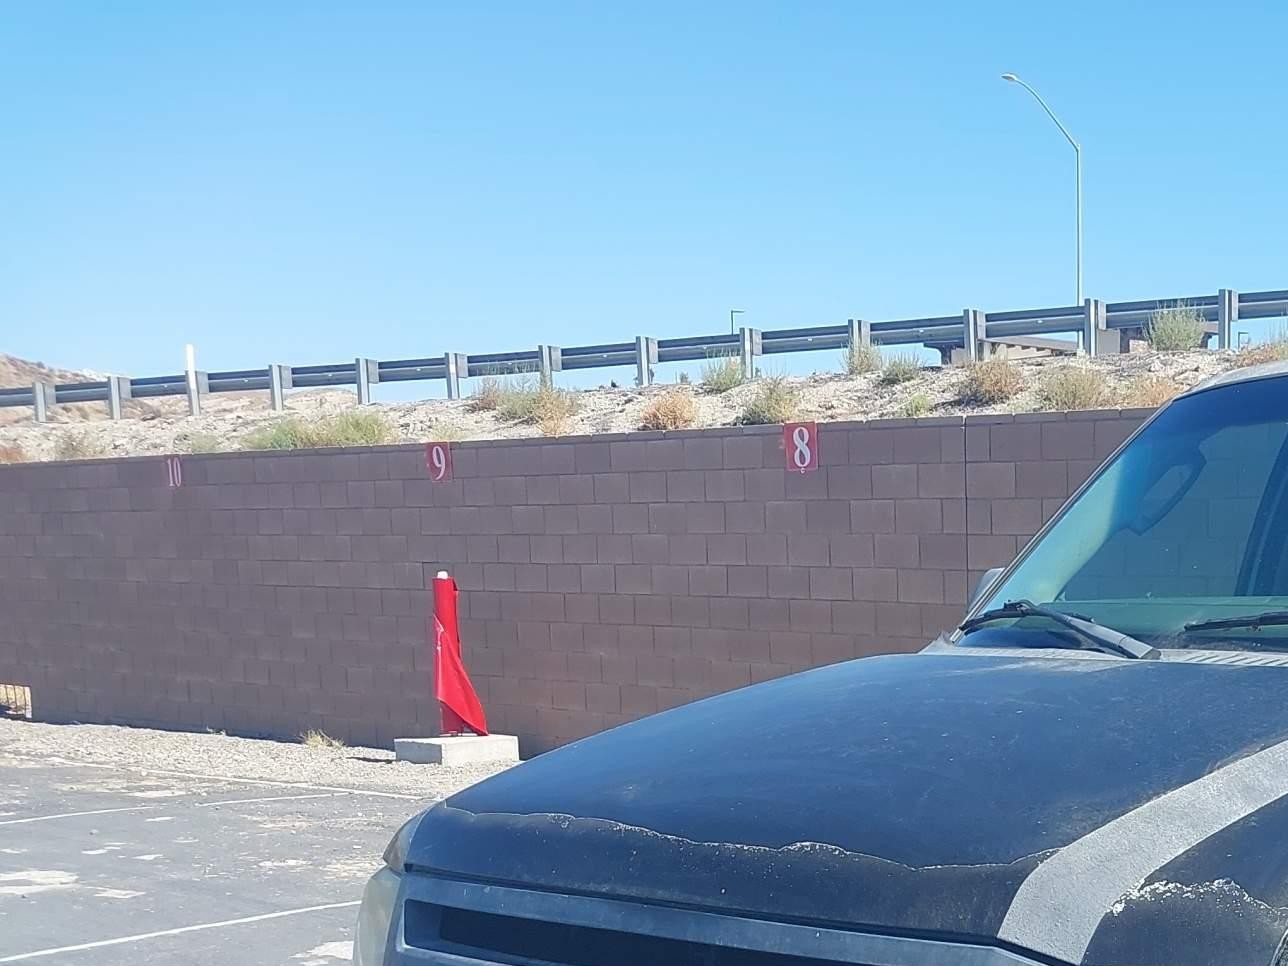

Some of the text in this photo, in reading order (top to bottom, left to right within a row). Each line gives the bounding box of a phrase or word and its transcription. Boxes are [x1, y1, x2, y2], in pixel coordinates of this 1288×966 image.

[432, 445, 446, 480] 9
[793, 426, 811, 468] 8
[166, 457, 182, 487] 10
